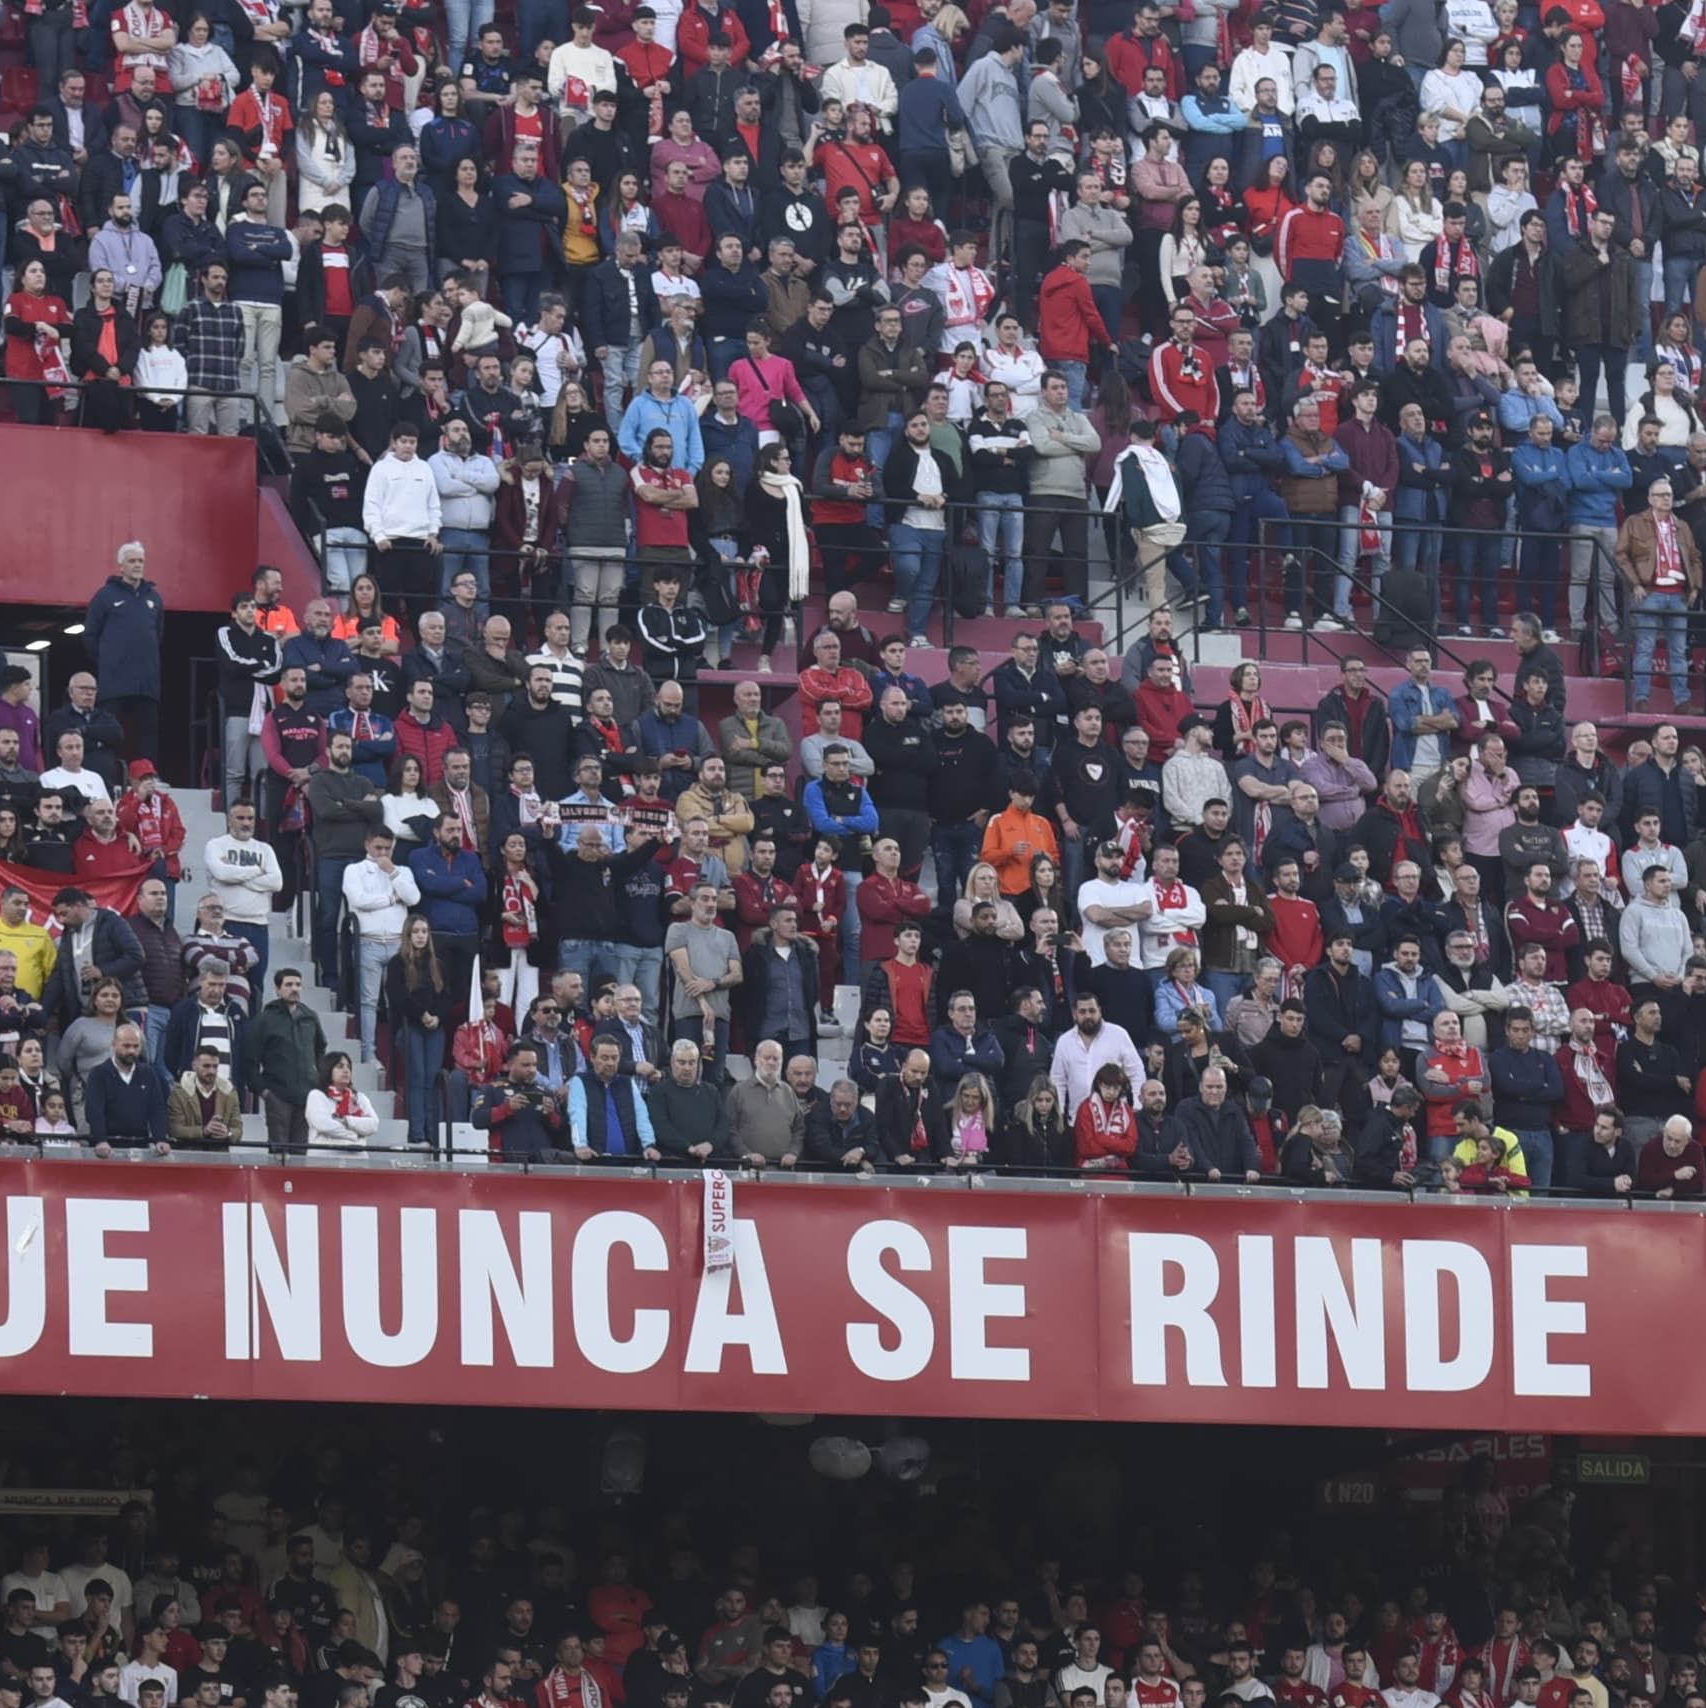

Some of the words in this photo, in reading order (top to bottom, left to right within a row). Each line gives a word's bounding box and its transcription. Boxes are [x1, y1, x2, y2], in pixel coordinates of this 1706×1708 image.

[224, 1201, 788, 1376] NUNCA
[844, 1218, 1031, 1383] SE
[1128, 1231, 1592, 1397] RINDE
[1581, 1458, 1645, 1478] SALIDA
